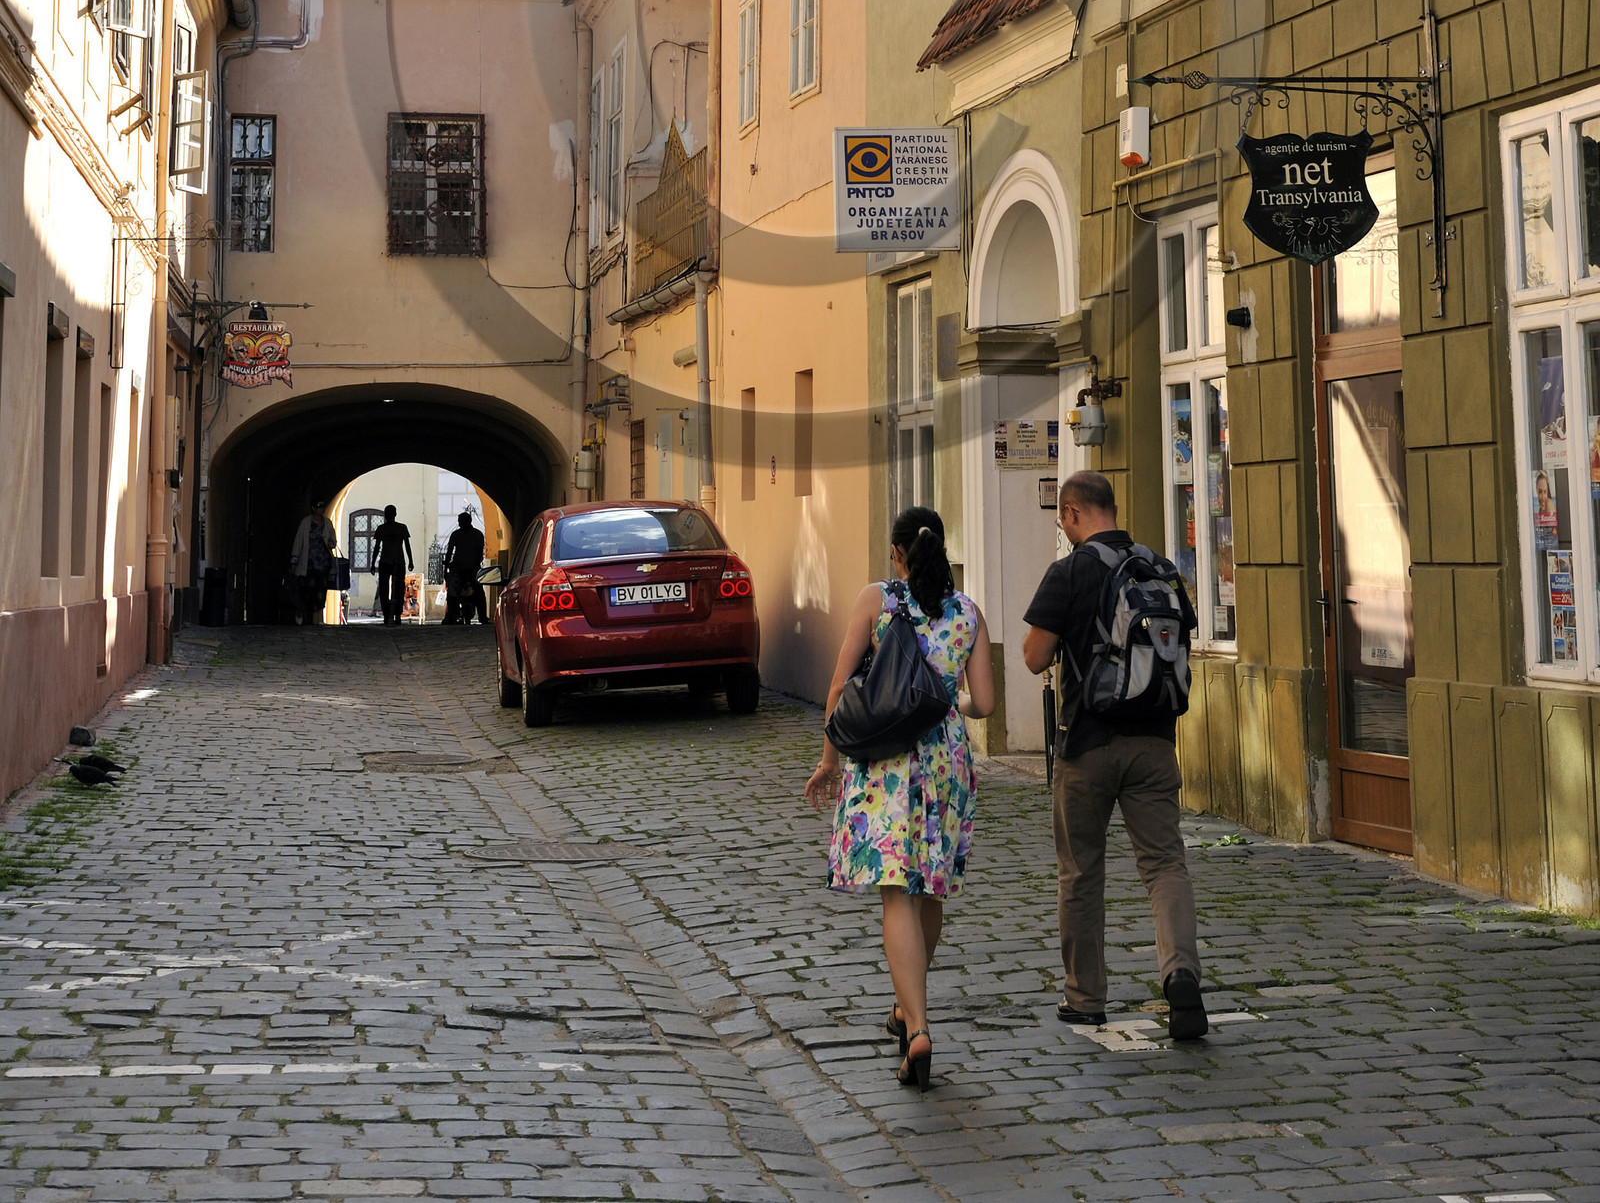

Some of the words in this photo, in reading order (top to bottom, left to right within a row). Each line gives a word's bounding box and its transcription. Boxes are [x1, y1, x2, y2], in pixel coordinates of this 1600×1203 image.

[895, 135, 948, 143] PARTIDUL
[895, 146, 948, 155] NAȚIONAL
[1302, 142, 1314, 152] de
[1316, 141, 1347, 152] turism
[895, 167, 948, 177] CREȘTIN
[1281, 157, 1334, 185] net
[896, 177, 948, 186] DEMOCRAT
[847, 187, 895, 202] PNȚCD
[1256, 186, 1363, 209] Transylvania
[233, 324, 283, 332] RESTAURANT
[617, 587, 635, 601] BV
